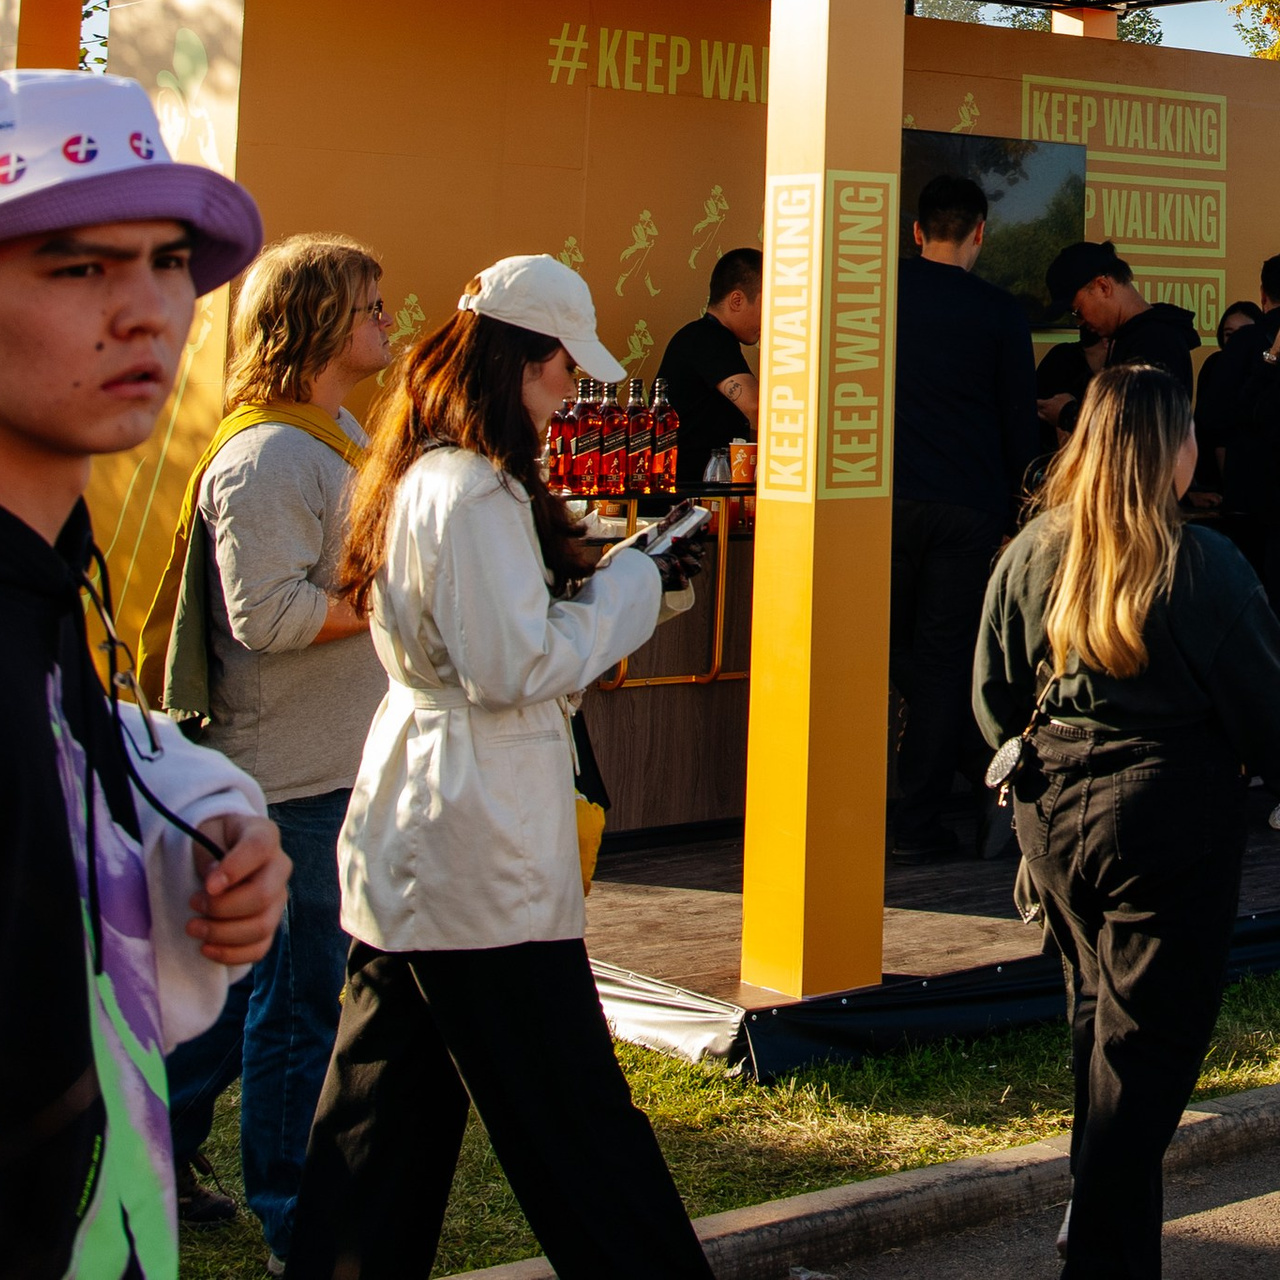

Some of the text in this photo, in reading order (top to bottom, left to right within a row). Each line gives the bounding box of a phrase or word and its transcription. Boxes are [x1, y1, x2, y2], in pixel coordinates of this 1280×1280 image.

[597, 27, 691, 95] KEEP
[1032, 90, 1218, 156] KEEP WALKING
[1102, 188, 1217, 243] WALKING
[768, 188, 811, 486] KEEP WALKING
[831, 186, 884, 483] KEEP WALKING
